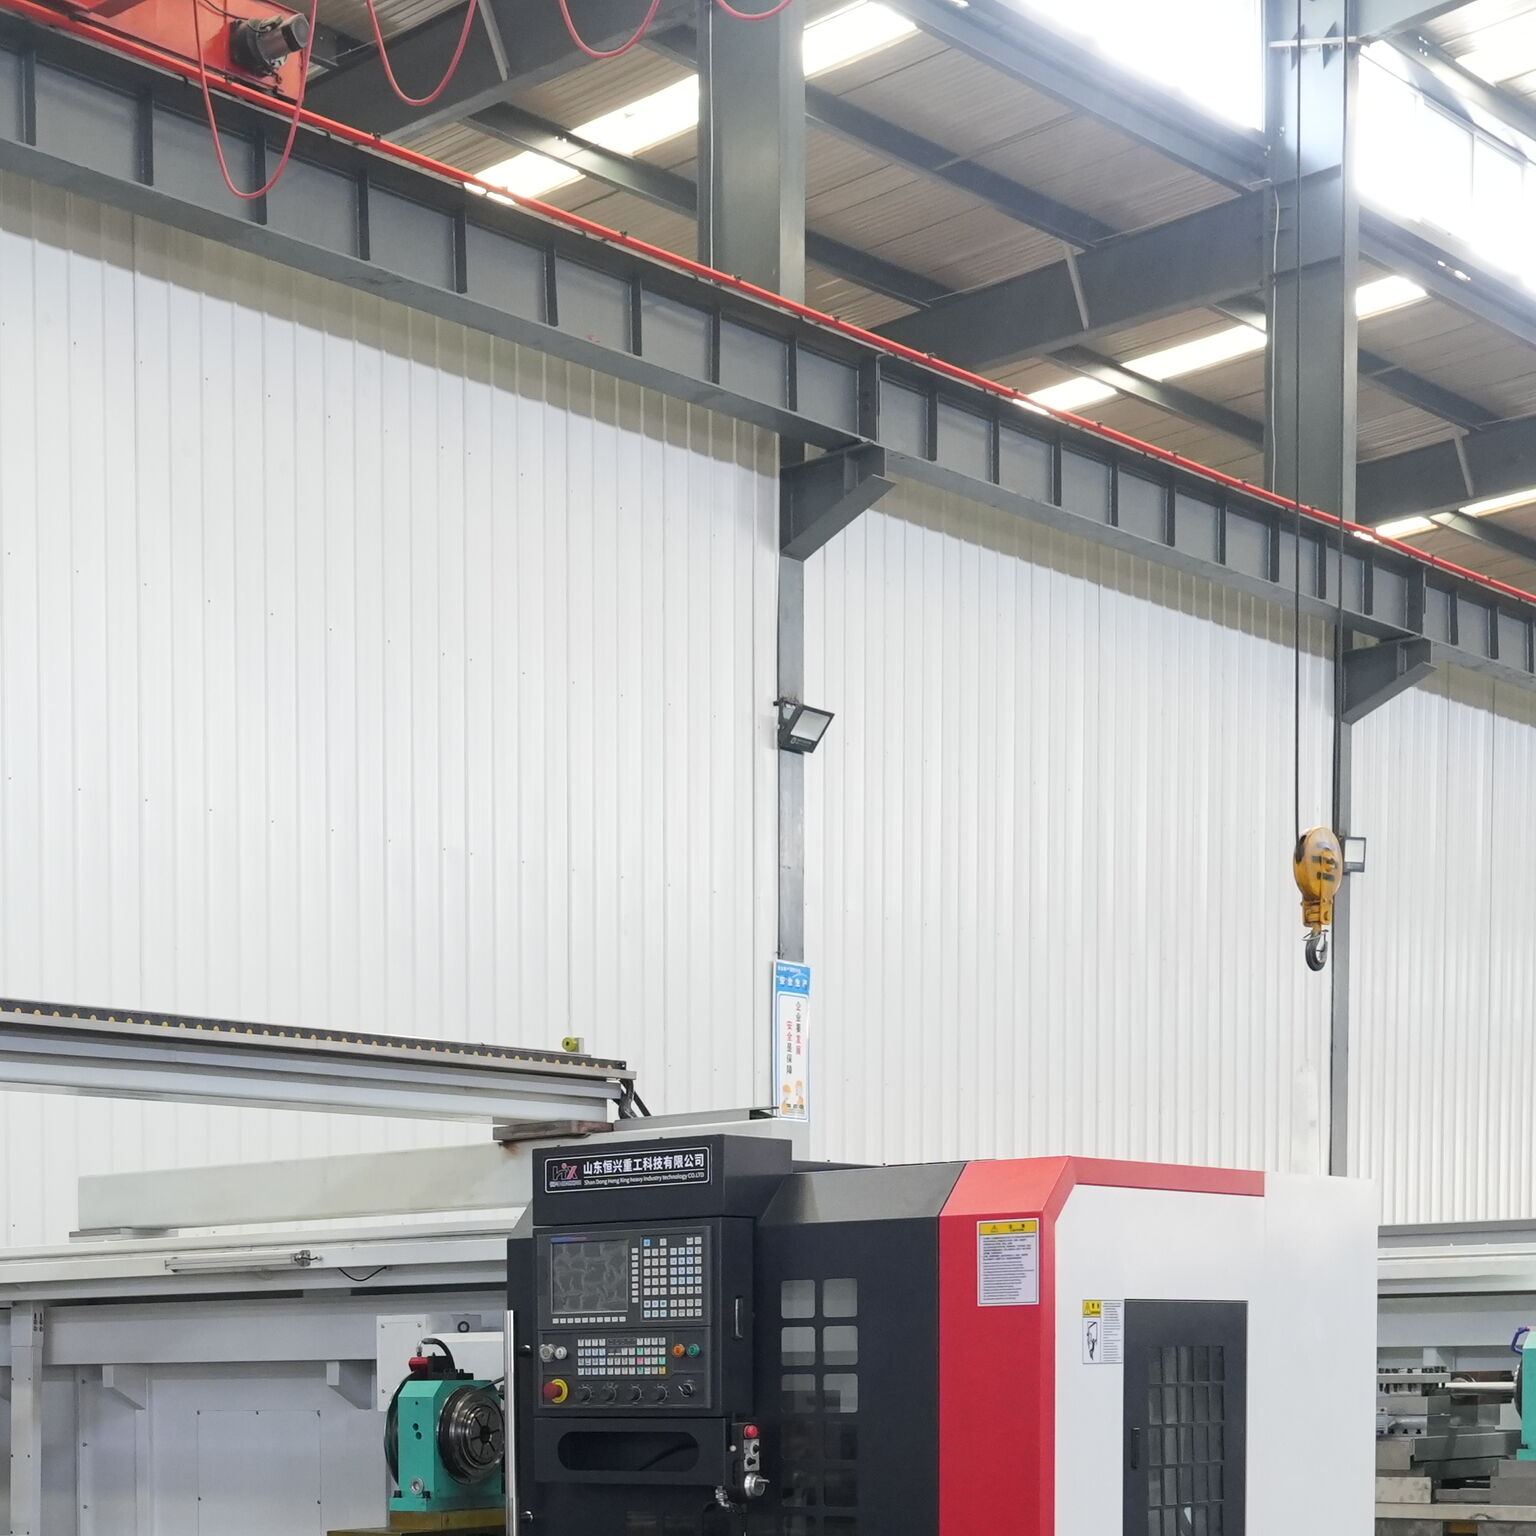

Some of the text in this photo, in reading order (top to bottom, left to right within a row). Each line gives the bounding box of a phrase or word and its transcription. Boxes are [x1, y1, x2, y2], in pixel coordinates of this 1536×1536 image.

[583, 1153, 705, 1175] 山东恒兴重工科技有限公司
